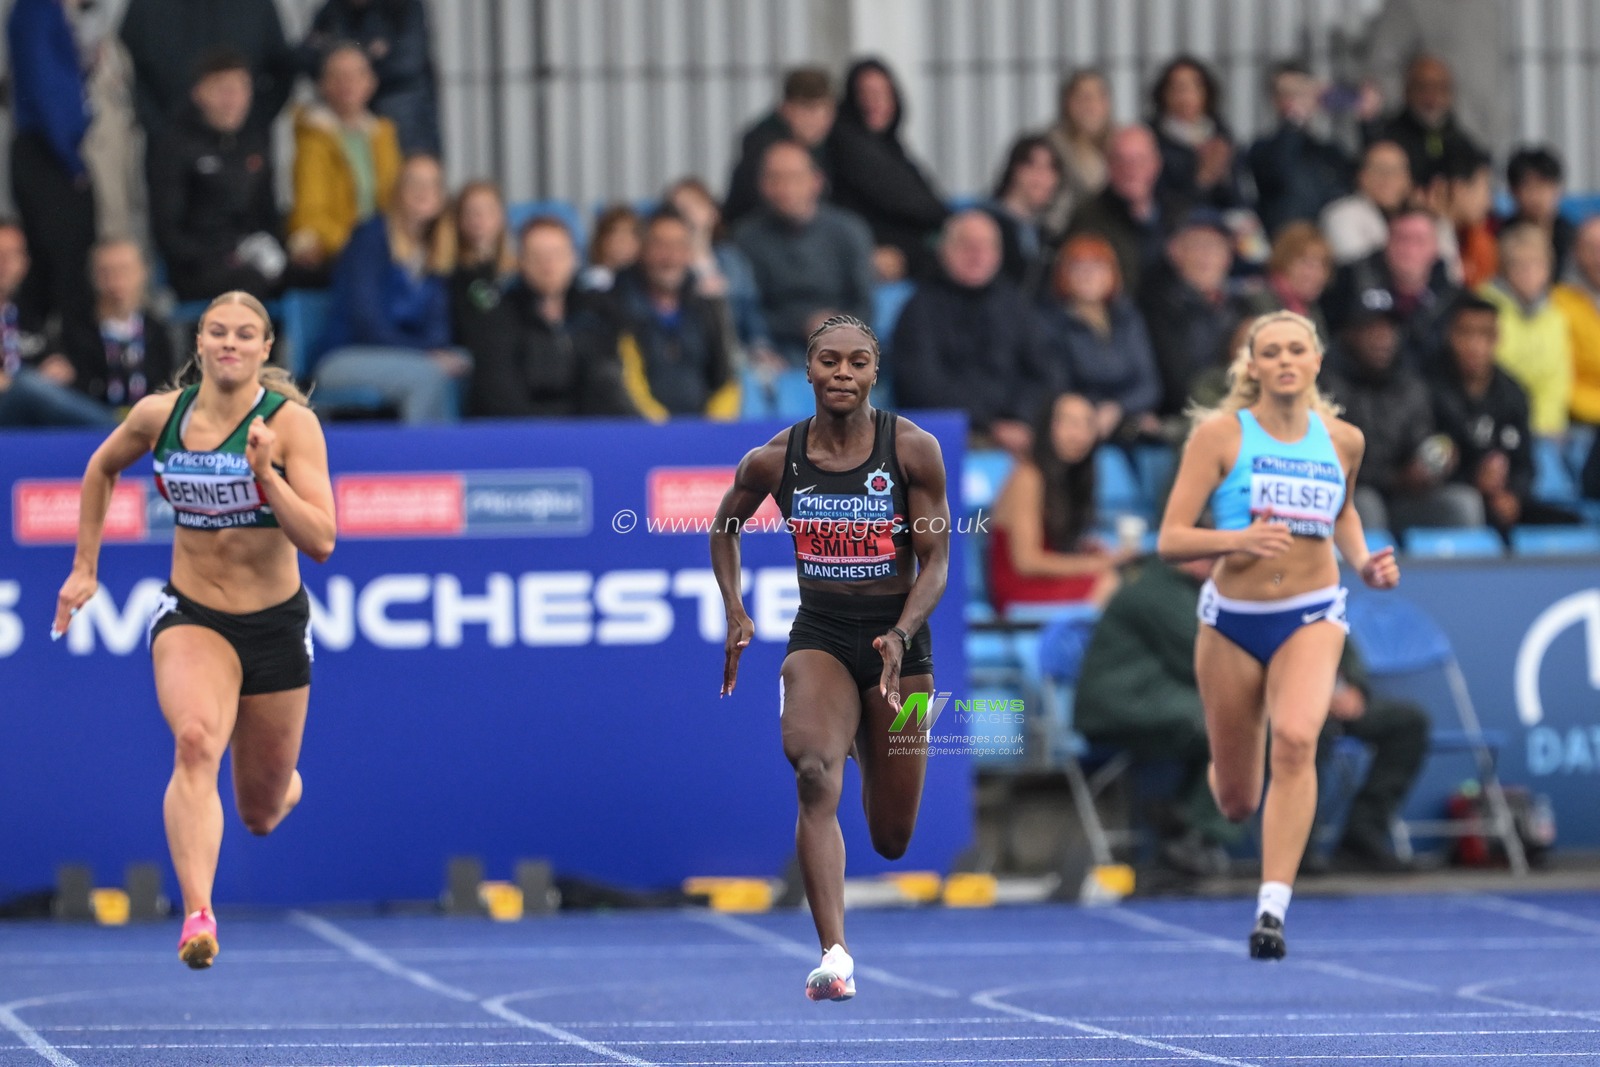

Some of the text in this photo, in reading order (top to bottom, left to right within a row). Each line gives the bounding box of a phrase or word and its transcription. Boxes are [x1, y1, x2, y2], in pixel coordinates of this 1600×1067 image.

[168, 481, 250, 504] BENNETT
[1260, 481, 1337, 511] KELSEY
[178, 511, 257, 528] MANCHESTER
[806, 520, 881, 539] ASHER
[810, 539, 879, 556] SMITH
[804, 563, 890, 577] MANCHESTER
